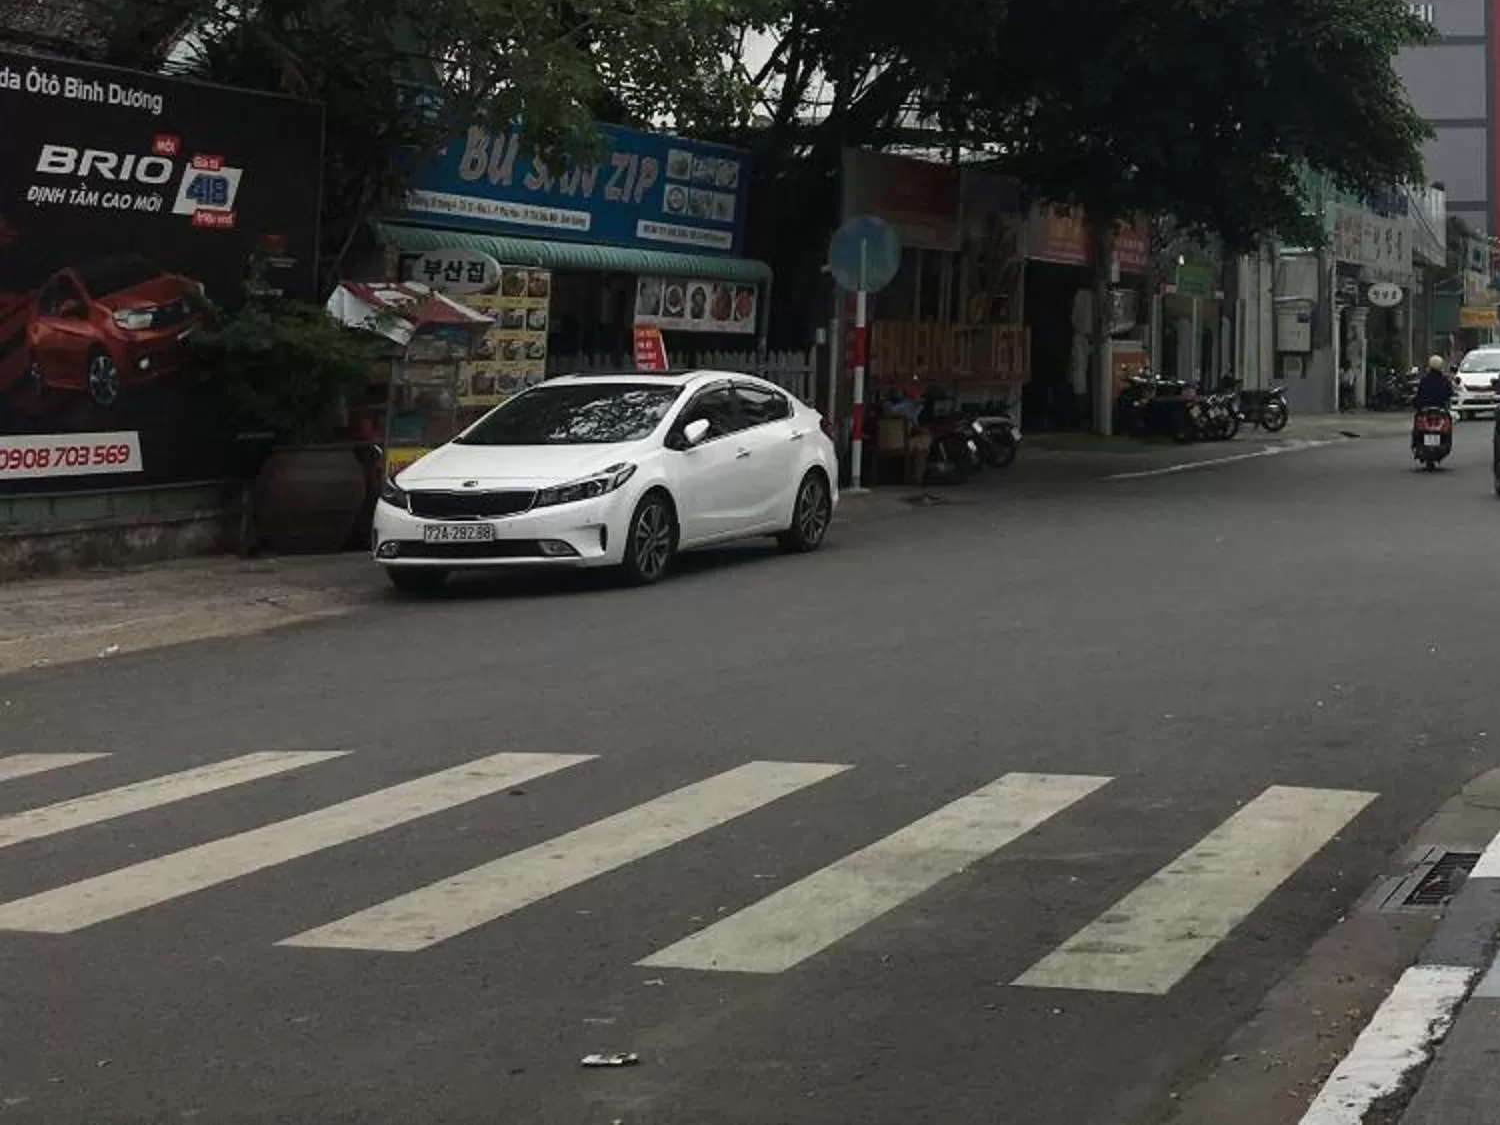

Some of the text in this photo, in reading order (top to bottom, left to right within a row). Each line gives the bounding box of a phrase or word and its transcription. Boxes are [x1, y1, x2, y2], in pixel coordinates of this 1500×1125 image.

[25, 65, 61, 96] Ôtô
[63, 76, 104, 104] Bình
[107, 83, 163, 116] Dương
[35, 144, 174, 184] BRIO
[604, 152, 660, 204] ZIP
[27, 182, 163, 213] ĐỊNH TẦM CAO MỚI
[423, 258, 485, 284] 부산집
[0, 444, 130, 469] 0908 703 569
